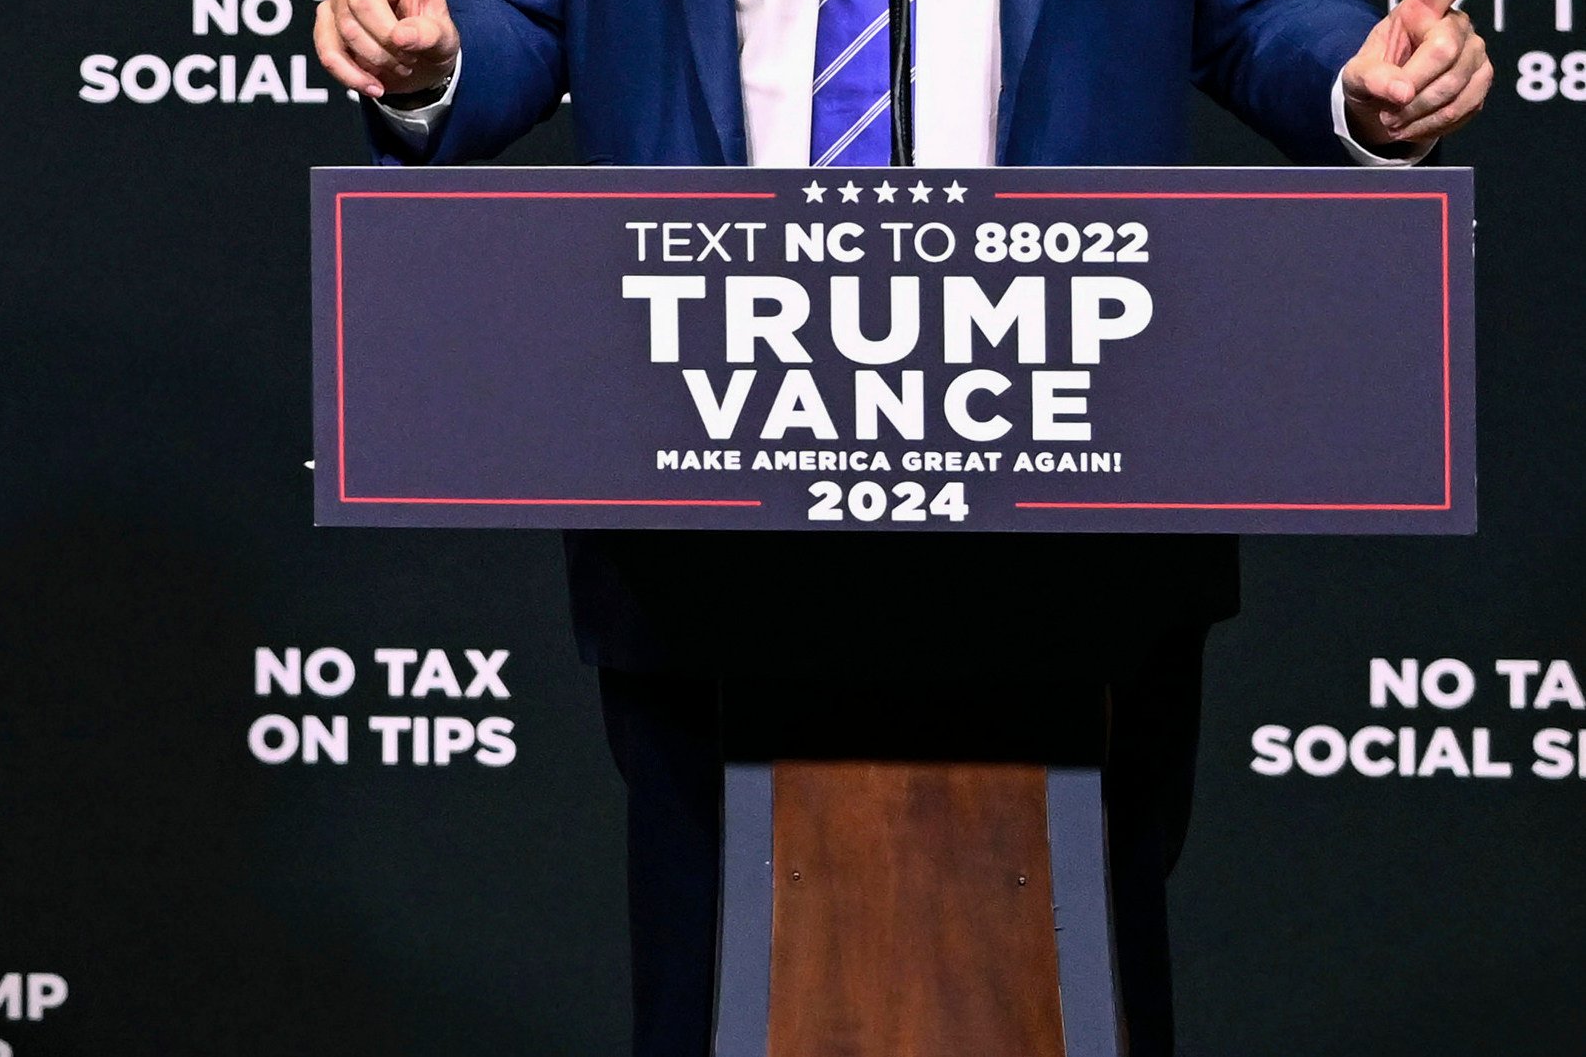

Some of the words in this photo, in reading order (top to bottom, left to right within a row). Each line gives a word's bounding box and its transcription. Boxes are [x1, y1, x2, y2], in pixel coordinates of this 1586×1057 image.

[78, 53, 329, 104] SOCIAL
[625, 222, 767, 262] TEXT
[785, 222, 866, 263] NC
[880, 222, 956, 263] TO
[974, 221, 1149, 263] 88022
[621, 275, 1154, 365] TRUMP
[681, 369, 1092, 442] VANCE
[656, 450, 742, 471] MAKE
[751, 450, 892, 472] AMERICA
[901, 450, 1002, 472] GREAT
[1012, 451, 1122, 473] AGAIN!
[807, 480, 969, 522] 2024
[255, 646, 356, 697] NO
[374, 648, 512, 699] TAX
[1369, 657, 1476, 710] NO
[248, 713, 349, 765] ON
[368, 715, 517, 767] TIPS
[1250, 724, 1513, 778] SOCIAL
[1531, 727, 1586, 779] S
